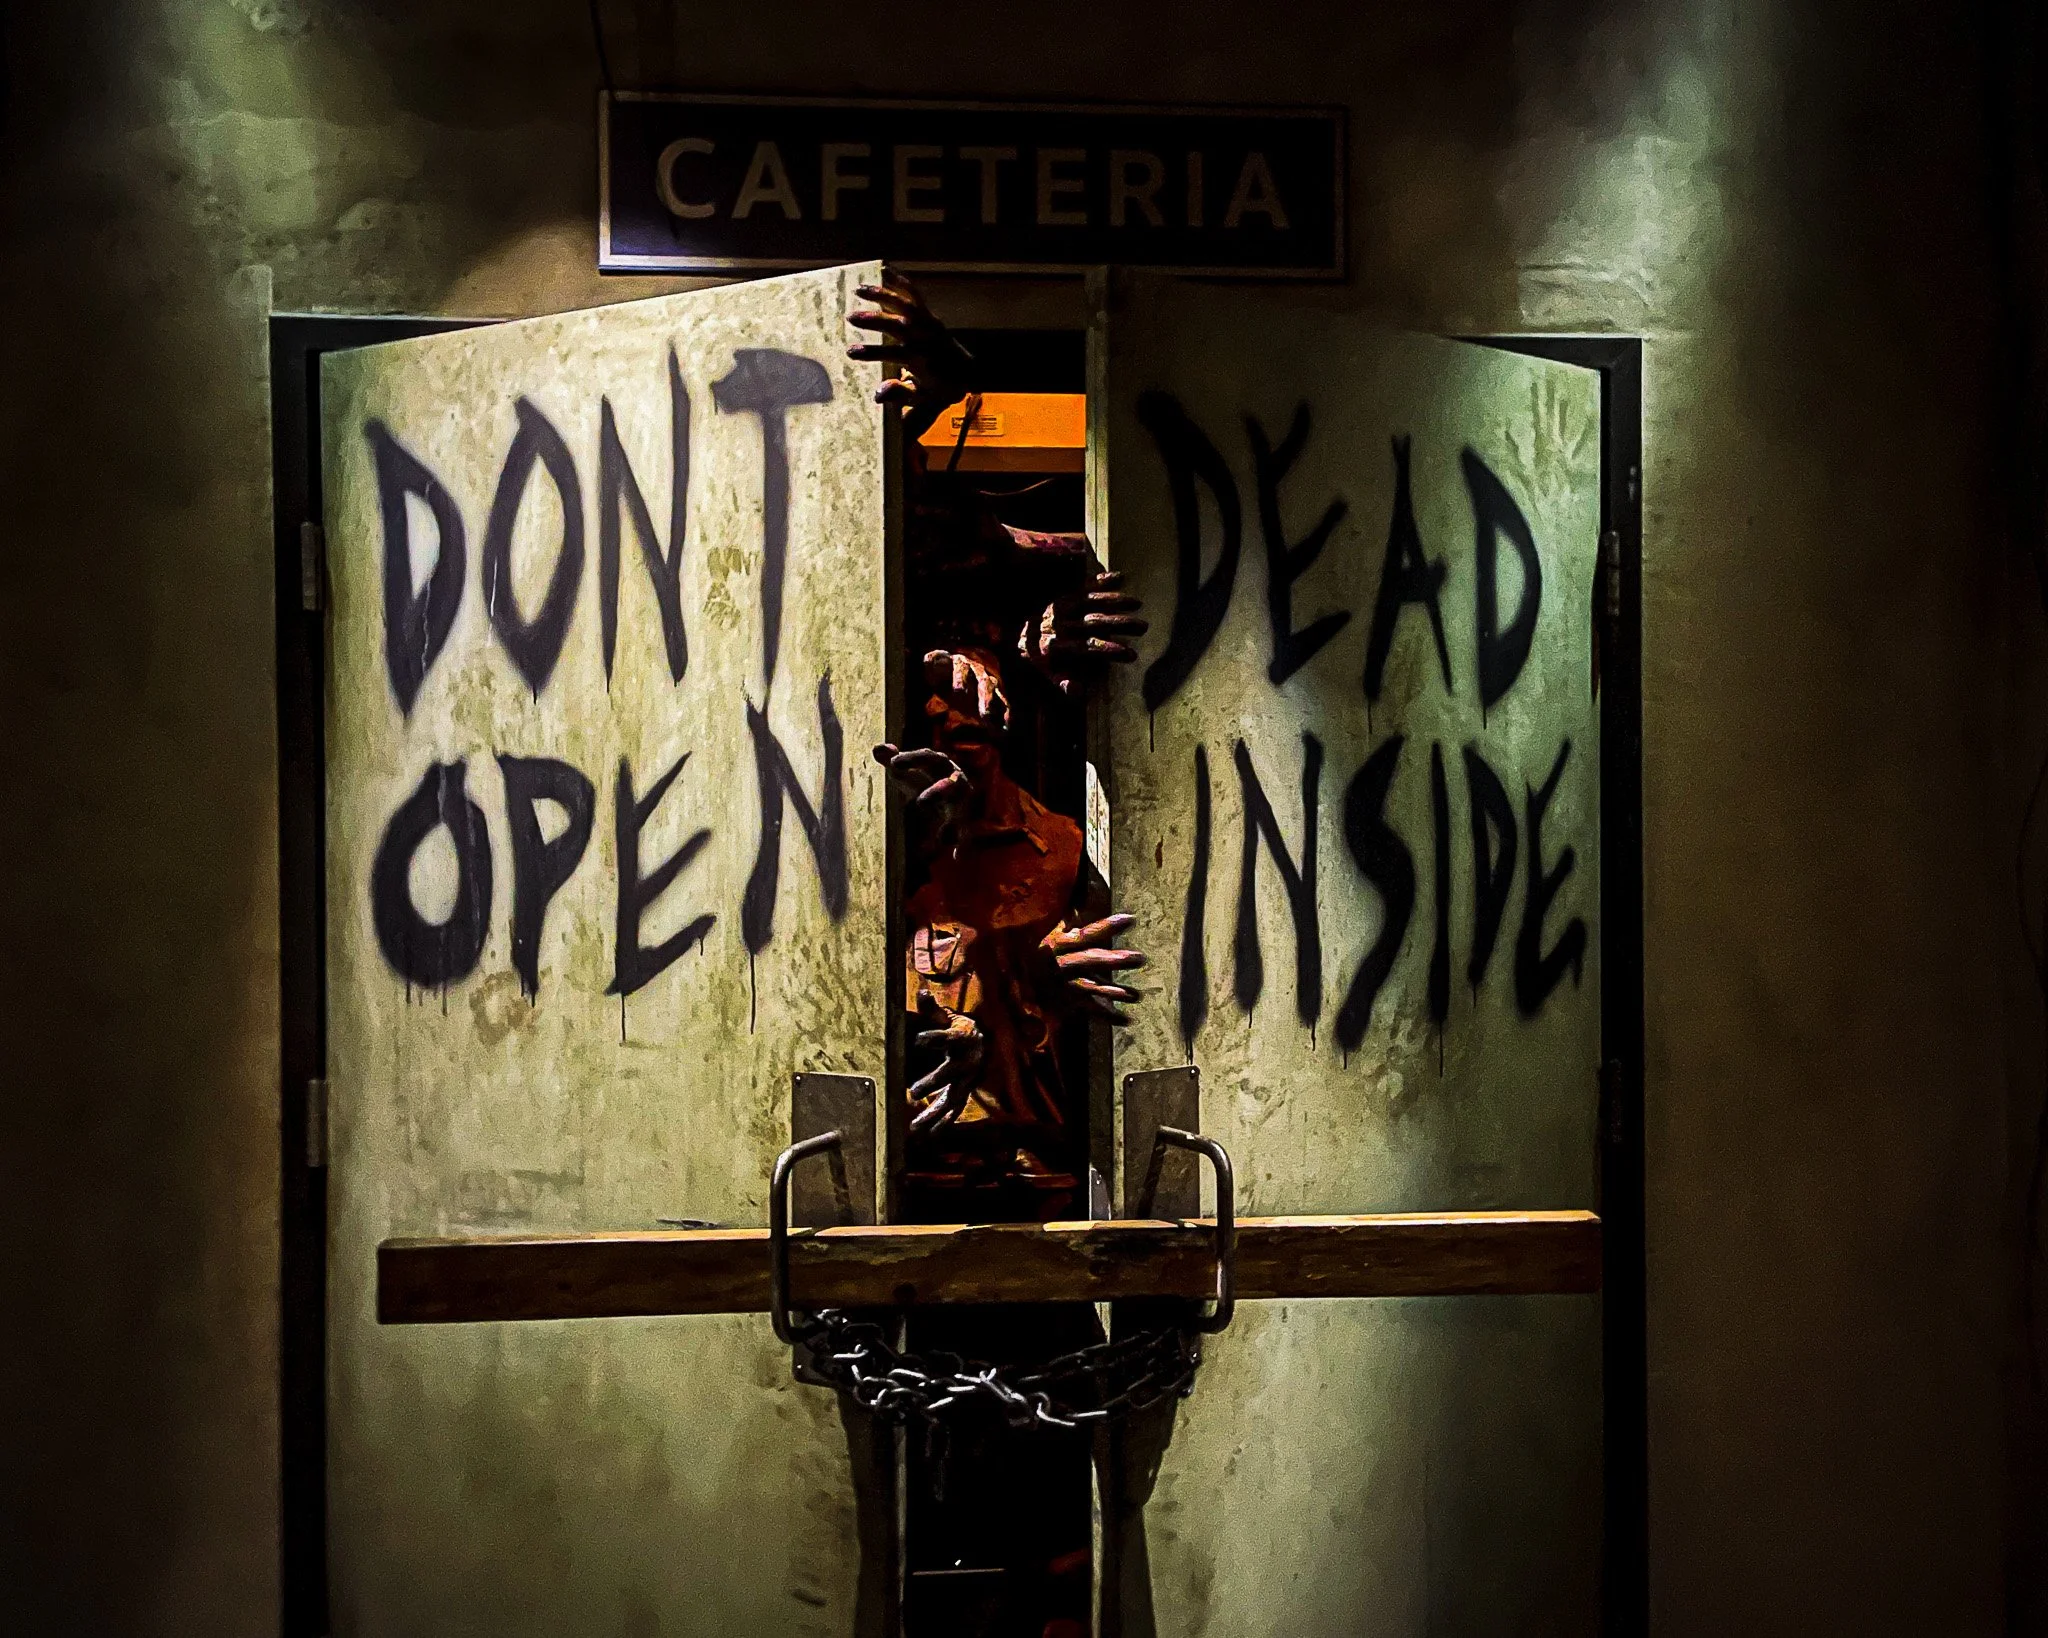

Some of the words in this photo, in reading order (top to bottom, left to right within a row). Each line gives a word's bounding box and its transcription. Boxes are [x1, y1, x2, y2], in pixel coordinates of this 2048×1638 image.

[654, 137, 1292, 230] CAFETERIA
[365, 341, 834, 719] DONT
[1138, 390, 1542, 713] DEAD
[371, 669, 849, 997] OPEN
[1178, 731, 1587, 1052] INSIDE
